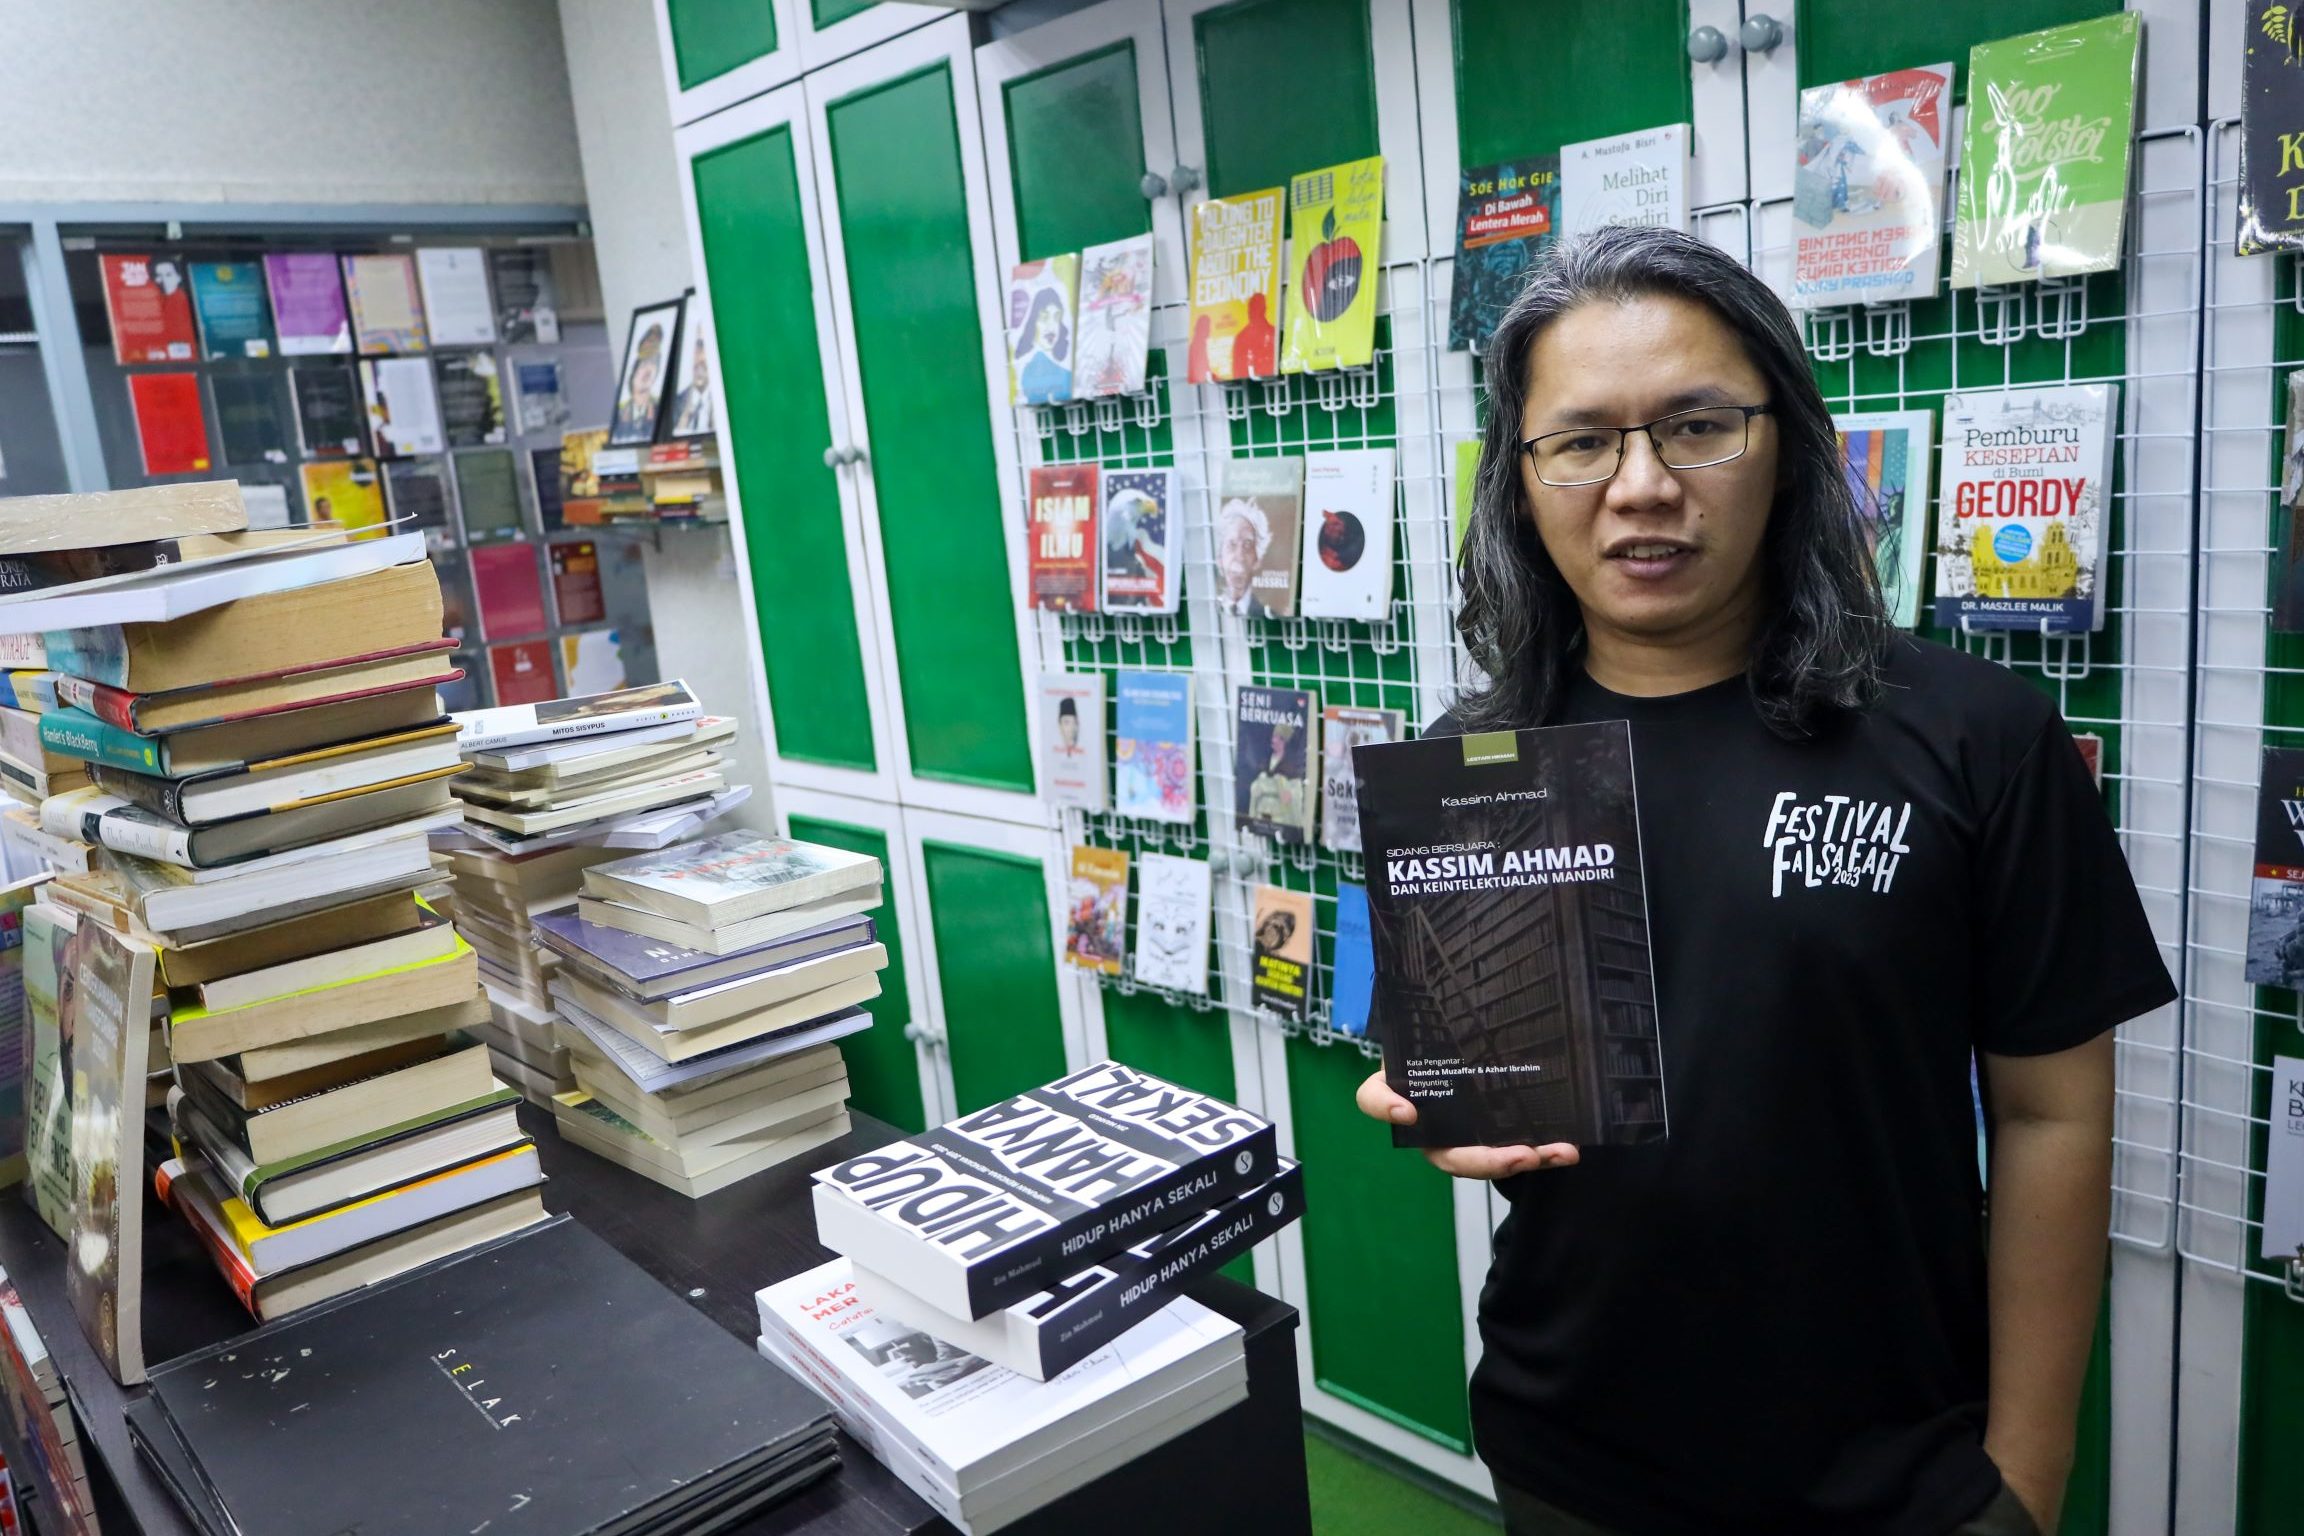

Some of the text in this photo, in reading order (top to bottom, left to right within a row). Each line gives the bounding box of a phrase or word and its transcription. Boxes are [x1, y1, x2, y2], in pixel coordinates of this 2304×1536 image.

[1635, 137, 1656, 149] Bisri
[1469, 171, 1553, 196] SOE HOK GIE
[1603, 166, 1668, 191] Melihat
[1257, 196, 1275, 220] TO
[1485, 194, 1533, 216] Di Bawah
[1636, 189, 1668, 207] Diri
[1470, 210, 1543, 231] Lentera Merah
[1608, 209, 1669, 227] Sendiri
[1198, 243, 1272, 276] ABOUT THE
[1197, 268, 1270, 306] ECONOMY
[1965, 425, 2080, 448] Pemburu
[1964, 446, 2080, 466] KESEPIAN
[1993, 467, 2044, 479] di Bumi
[1956, 478, 2086, 518] GEORDY
[1961, 601, 2064, 613] DR. MASZLEE MALIK
[1240, 691, 1272, 708] SENI
[552, 722, 606, 735] MITOS SISYPUS
[1240, 707, 1303, 728] BERKUASA
[65, 731, 100, 757] BlackBerry
[461, 737, 507, 748] ALBERT CAMUS
[1441, 788, 1547, 807] Kassim Ahmad
[1763, 792, 1911, 853] FESTIVAL
[1386, 846, 1429, 858] SIDANG
[1431, 841, 1494, 855] BERSUARA
[1387, 843, 1615, 883] KASSIM AHMAD
[1772, 836, 1900, 898] FALSAFAH
[1391, 868, 1615, 896] DAN KEINTELEKTUALAN MANDIRI
[1832, 866, 1861, 887] 2023
[1406, 1059, 1422, 1067] Kata
[1424, 1057, 1460, 1069] Pengantar
[1407, 1063, 1540, 1077] Chandra Muzaffar & Azhar Ibrahim
[1408, 1078, 1449, 1088] Penyunting
[1409, 1088, 1454, 1098] Zarif Asyraf
[1052, 1062, 1256, 1147] SEKALI
[957, 1096, 1168, 1197] HANYA
[831, 1152, 1046, 1261] HIDUP
[1062, 1171, 1217, 1255] HIDUP HANYA SEKALI
[1008, 1257, 1042, 1278] Mahmud
[1120, 1215, 1253, 1308] HIDUP HANYA SEKALI
[1075, 1310, 1103, 1333] Mahmud
[438, 1348, 521, 1428] SELAK
